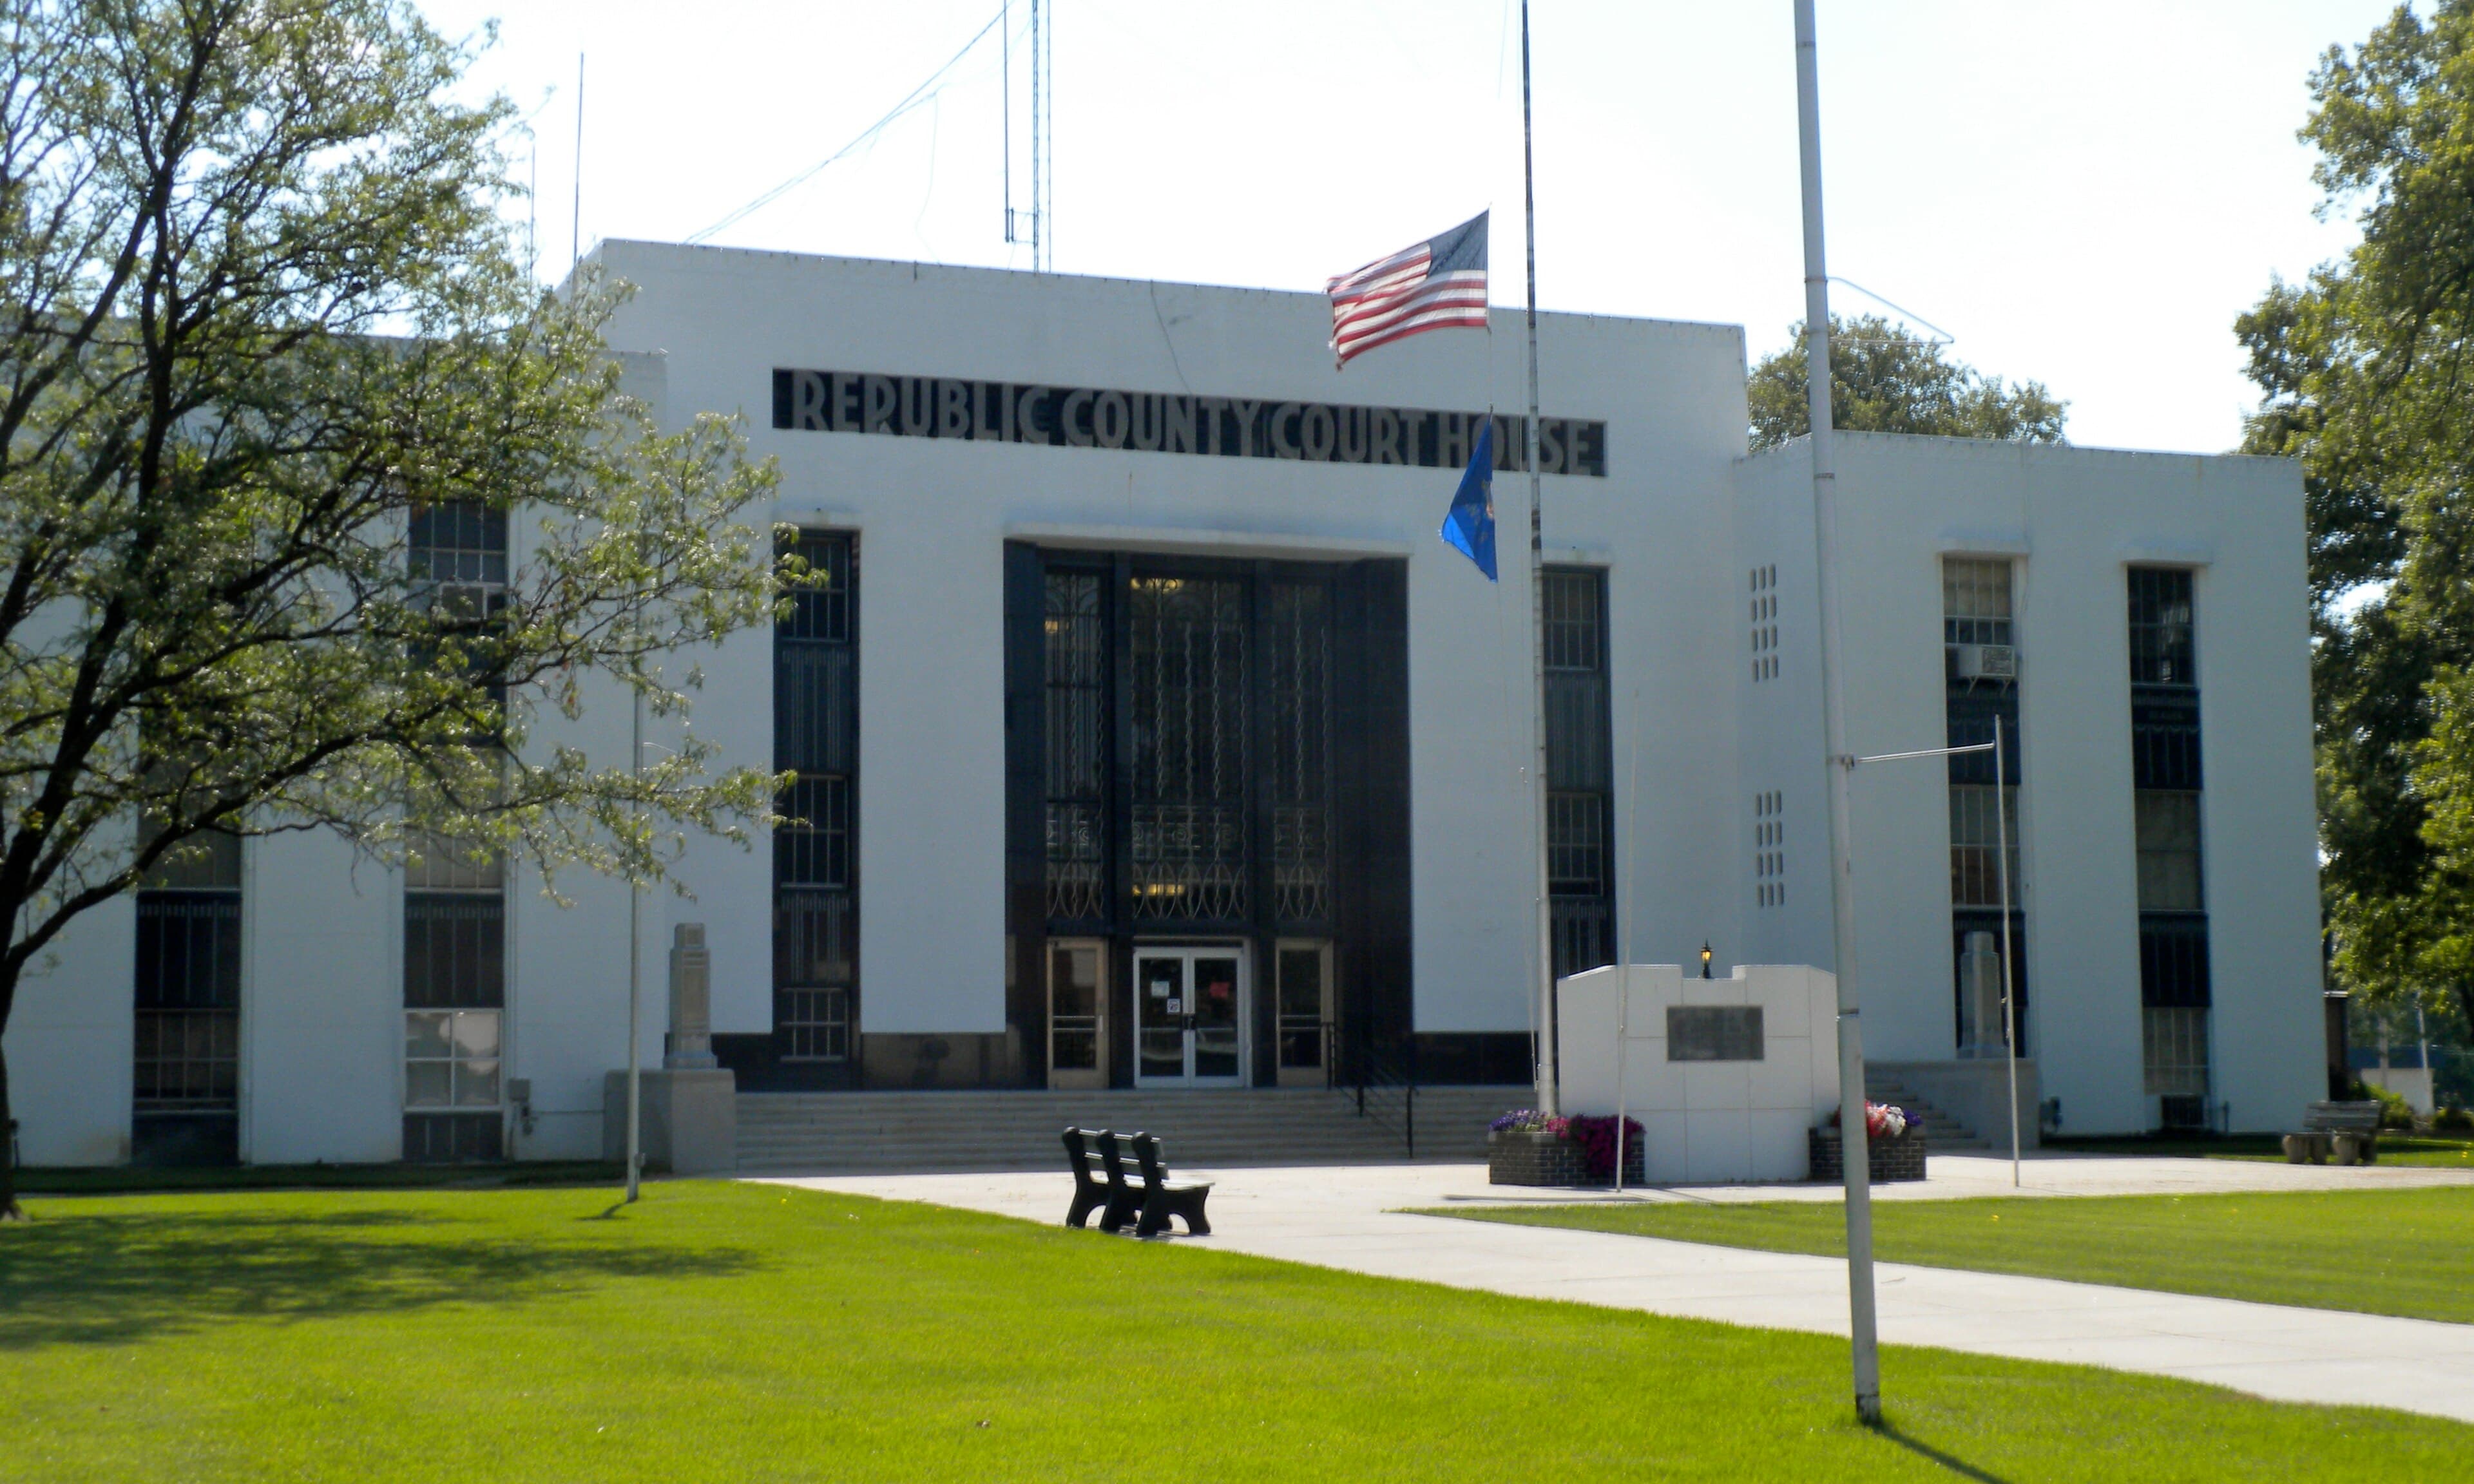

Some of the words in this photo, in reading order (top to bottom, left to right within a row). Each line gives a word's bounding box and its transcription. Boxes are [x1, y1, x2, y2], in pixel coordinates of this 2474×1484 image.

[792, 370, 1050, 444] REPUBLIC
[1062, 389, 1262, 457] COUNTY
[1271, 401, 1426, 466] COURT
